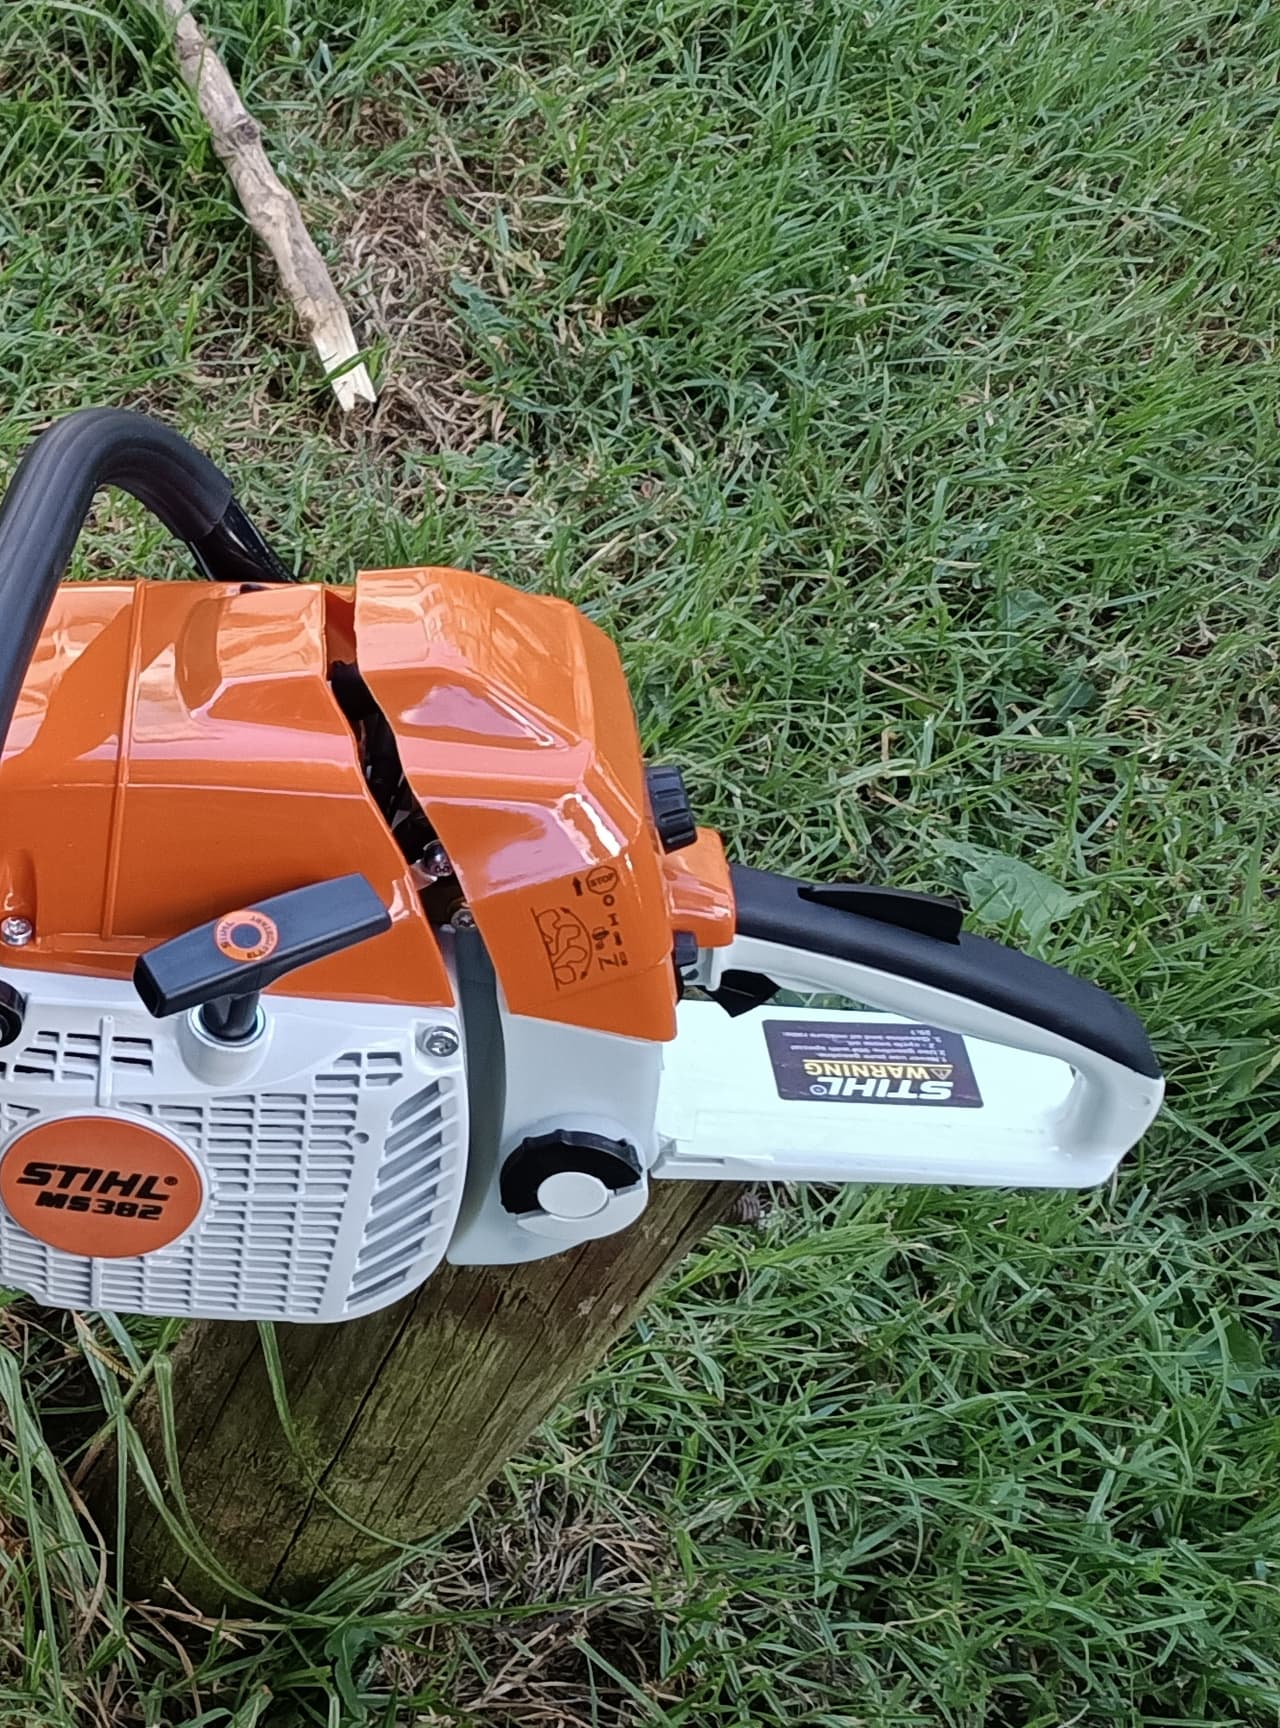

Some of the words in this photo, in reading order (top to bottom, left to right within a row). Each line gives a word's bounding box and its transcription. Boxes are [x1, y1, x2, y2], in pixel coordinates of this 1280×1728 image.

[590, 873, 616, 887] STOP
[803, 1062, 930, 1079] WARNING
[35, 1191, 164, 1220] MS382
